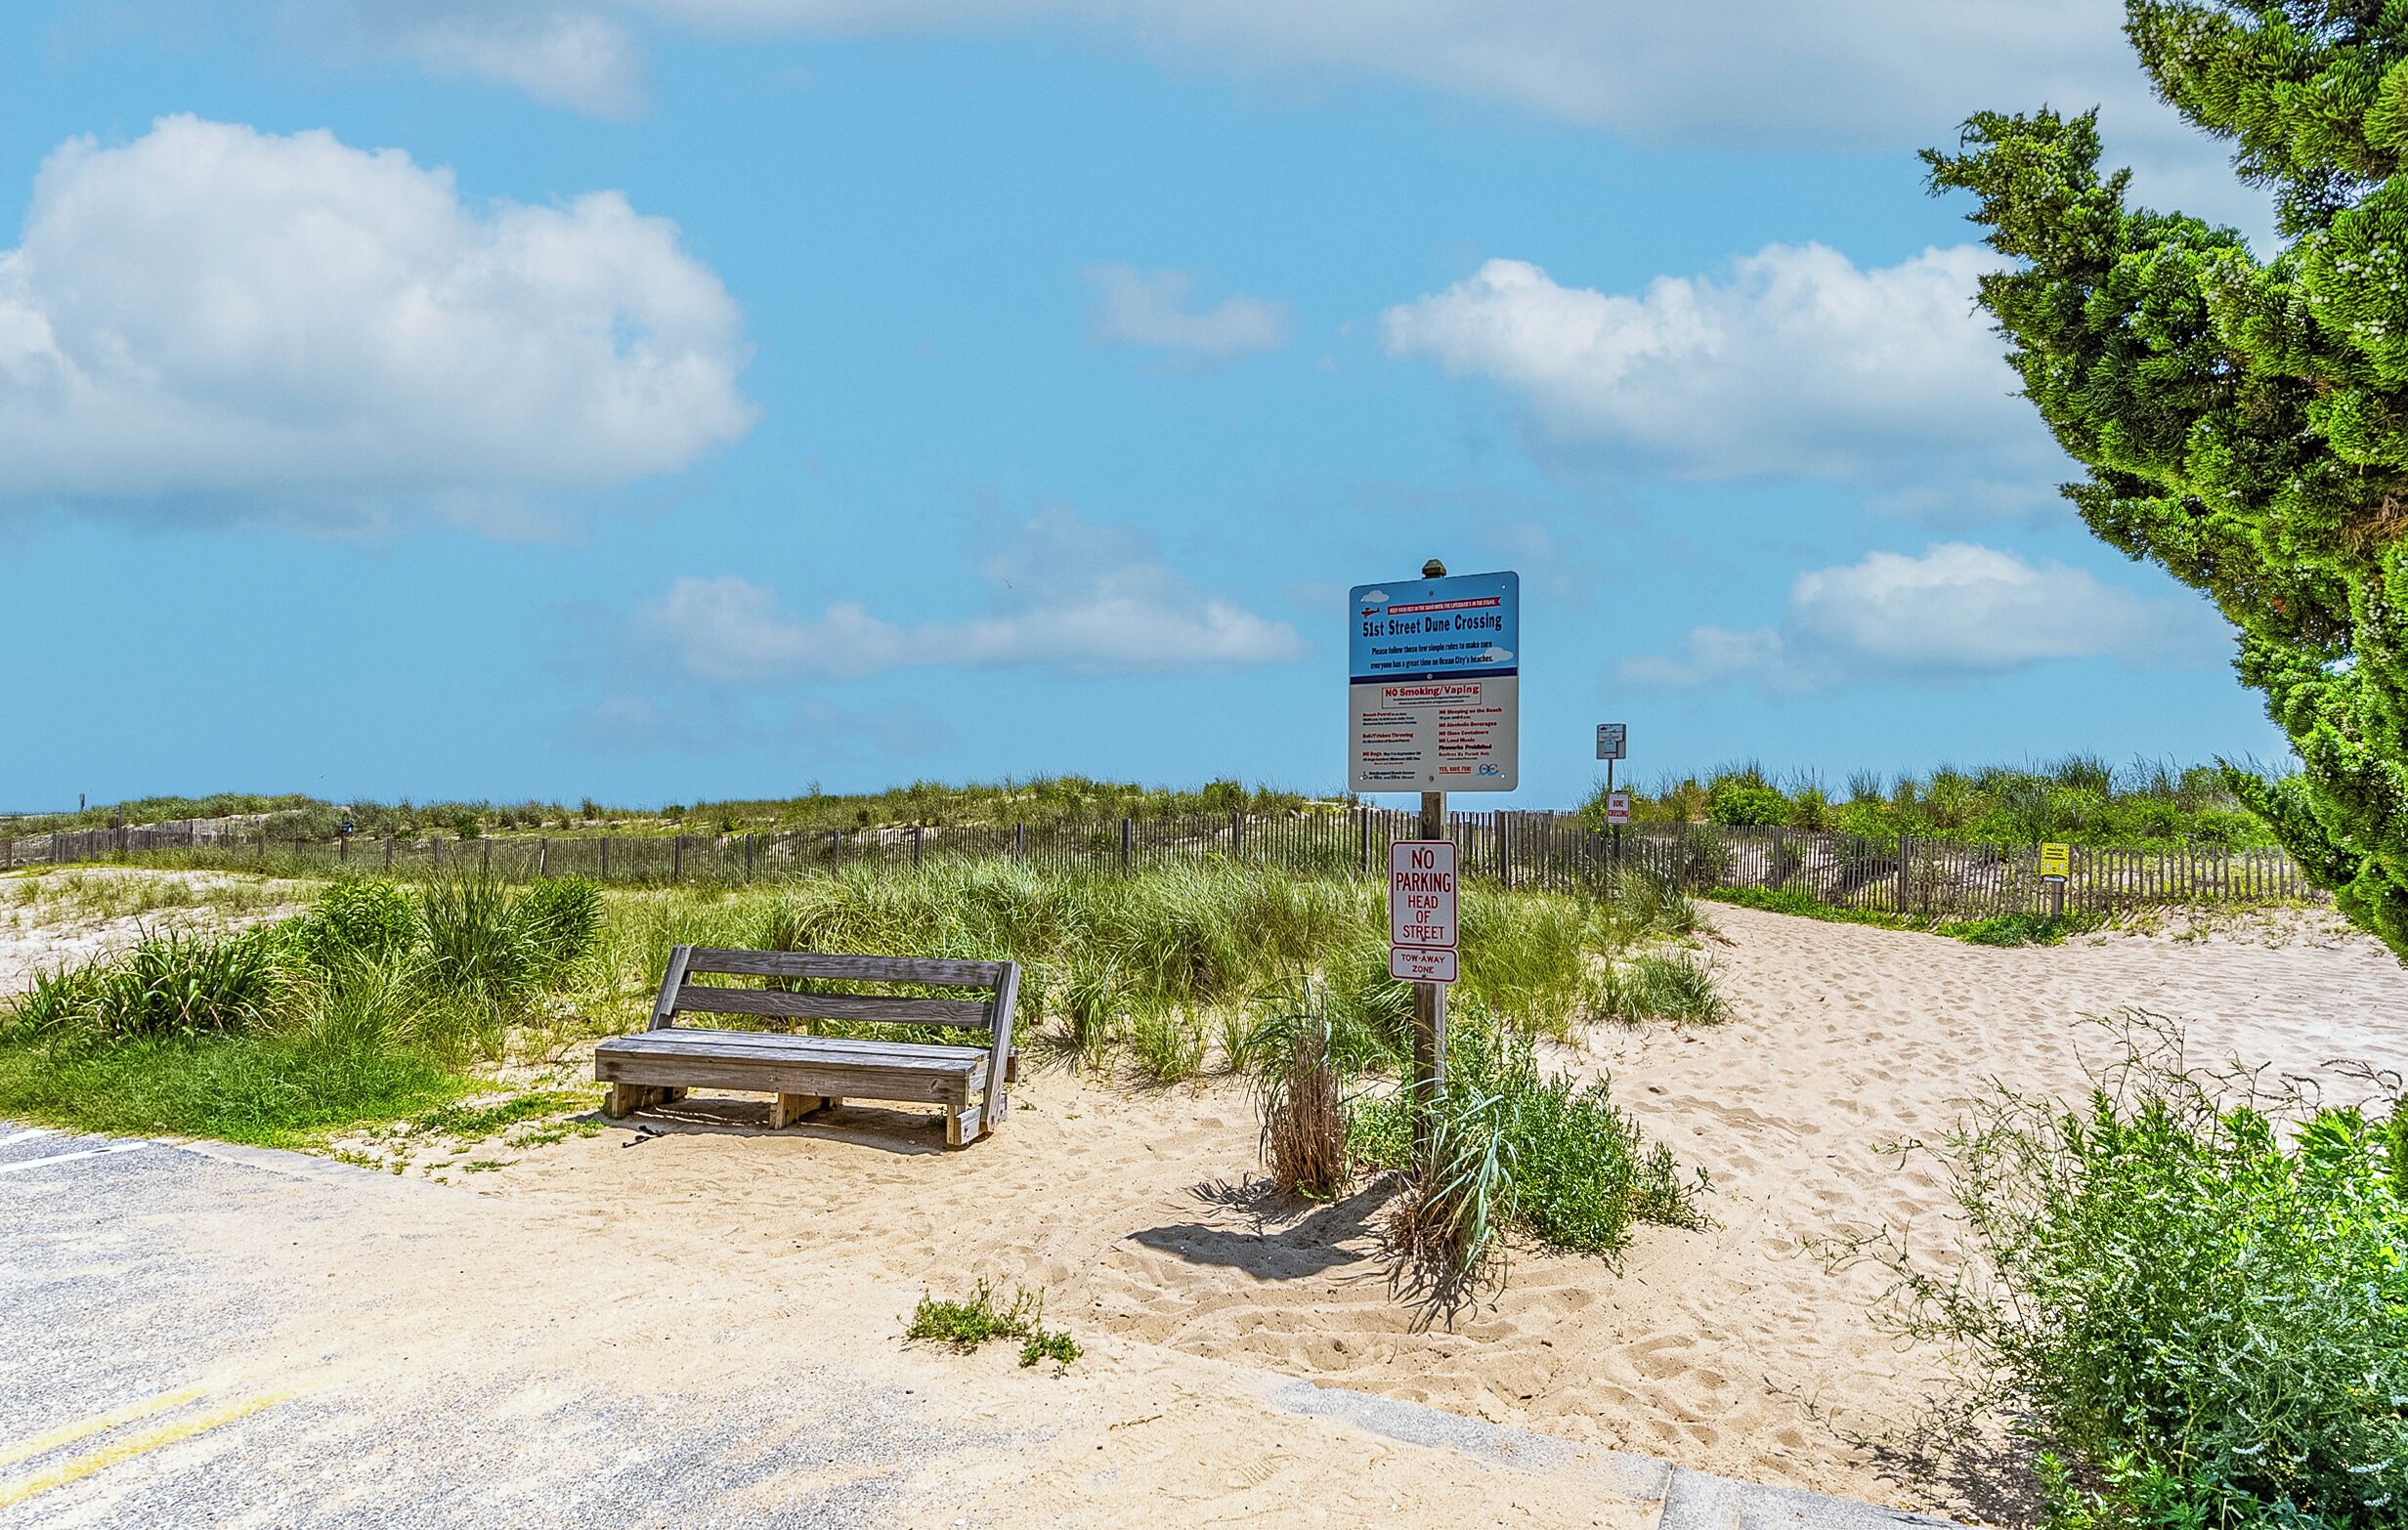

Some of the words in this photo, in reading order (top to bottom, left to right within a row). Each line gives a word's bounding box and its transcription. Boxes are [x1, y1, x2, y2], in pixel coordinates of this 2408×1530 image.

[1363, 621, 1384, 637] 51st
[1389, 618, 1420, 635] Street
[1425, 616, 1450, 632] Dune
[1455, 612, 1502, 631] Crossing
[1428, 643, 1445, 653] simple
[1445, 642, 1458, 650] rules
[1406, 660, 1419, 668] great
[1455, 655, 1469, 666] City's
[1470, 654, 1494, 663] beaches.
[1385, 688, 1398, 697] NO
[1399, 684, 1479, 696] Smoking/Vaping
[1411, 850, 1435, 870] NO
[1396, 872, 1451, 892] PARKING
[1408, 895, 1439, 909] HEAD
[1416, 910, 1431, 924] OF
[1403, 925, 1445, 940] STREET
[1401, 954, 1446, 964] TOW-AWAY
[1412, 965, 1434, 974] ZONE
